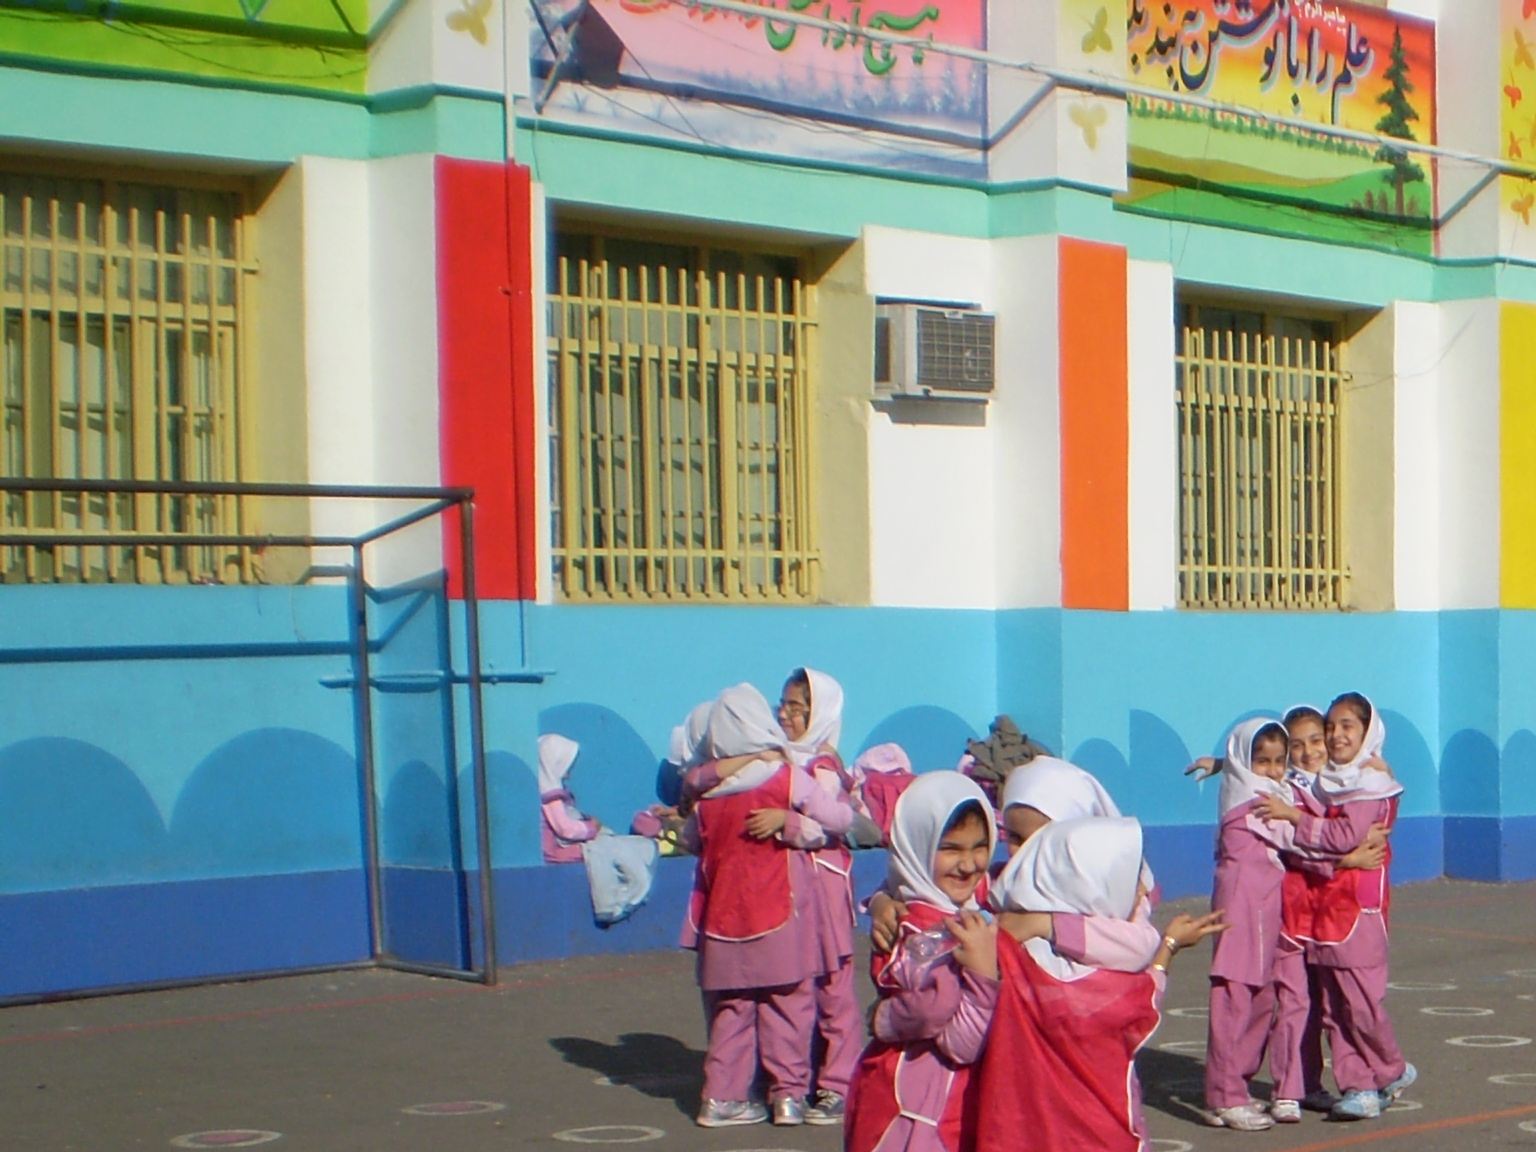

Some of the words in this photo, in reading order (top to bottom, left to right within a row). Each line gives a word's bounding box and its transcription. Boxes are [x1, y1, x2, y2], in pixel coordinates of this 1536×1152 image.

[1286, 13, 1302, 107] با
[1305, 27, 1329, 85] را
[1330, 22, 1370, 124] علم
